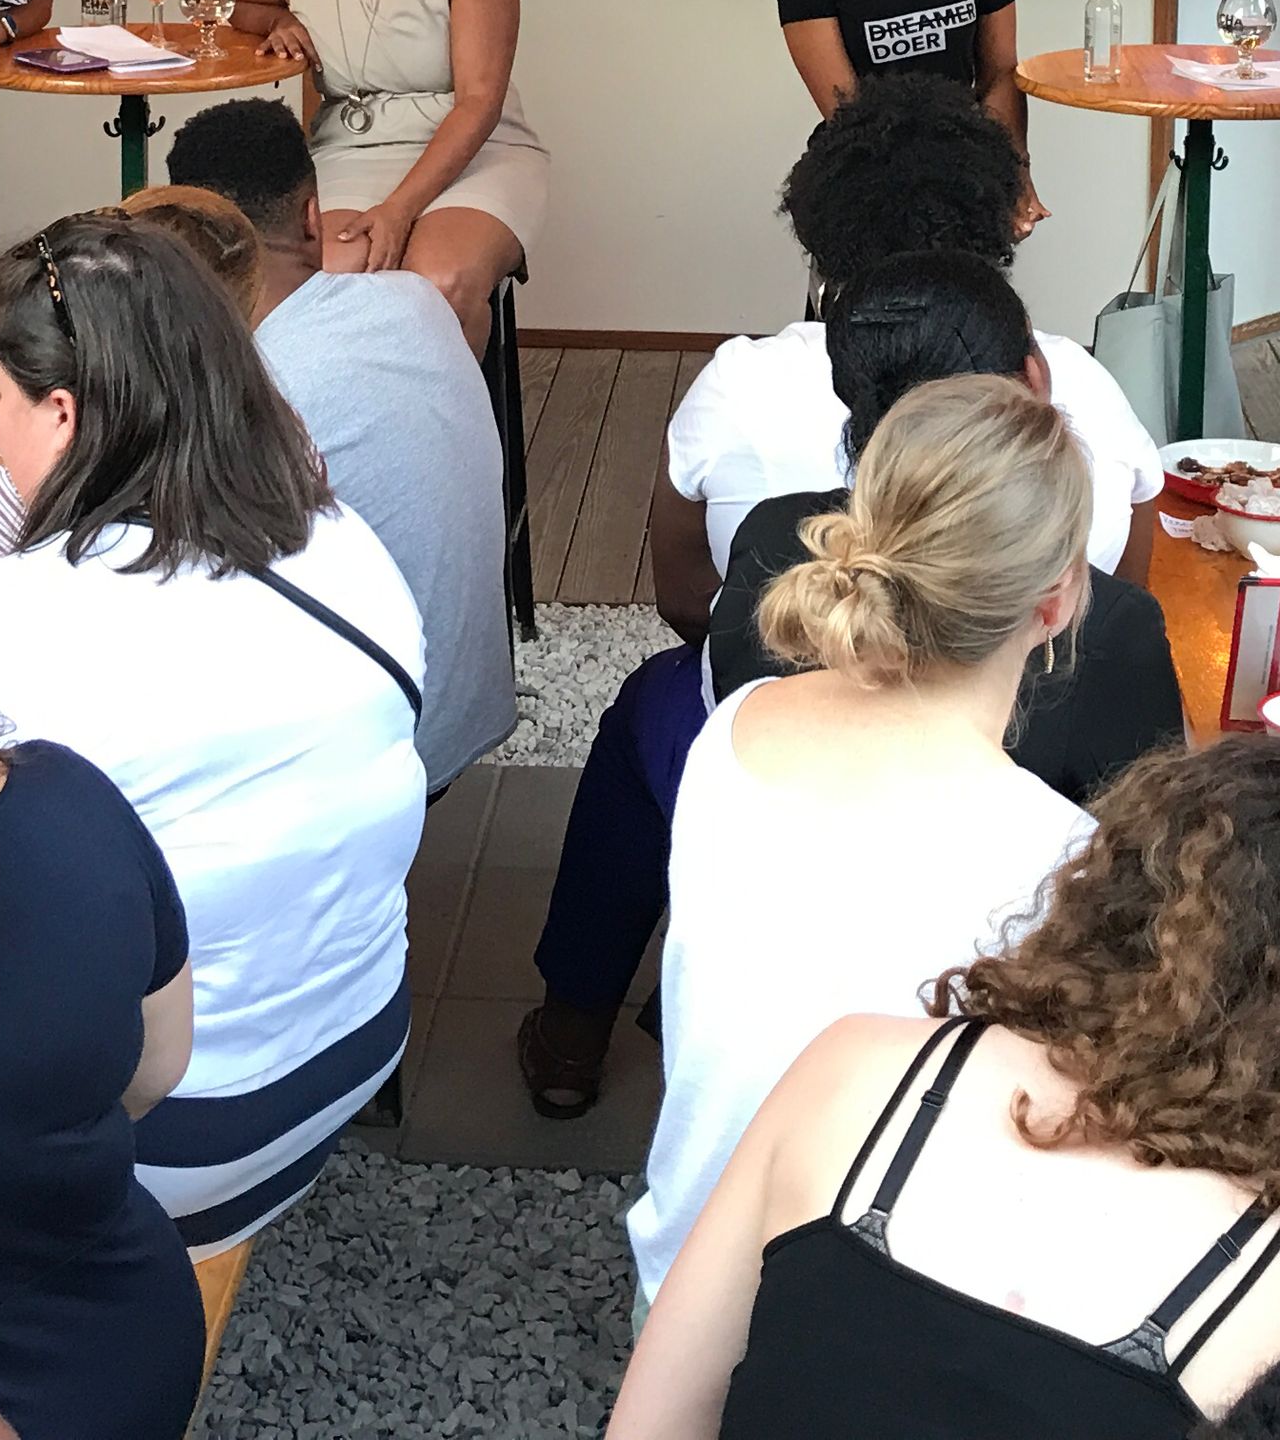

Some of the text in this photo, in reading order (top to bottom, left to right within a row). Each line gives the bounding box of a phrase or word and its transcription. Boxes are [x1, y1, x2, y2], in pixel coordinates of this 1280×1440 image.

[869, 0, 977, 43] DREAMER
[1219, 13, 1244, 30] CHA
[872, 32, 942, 61] DOER
